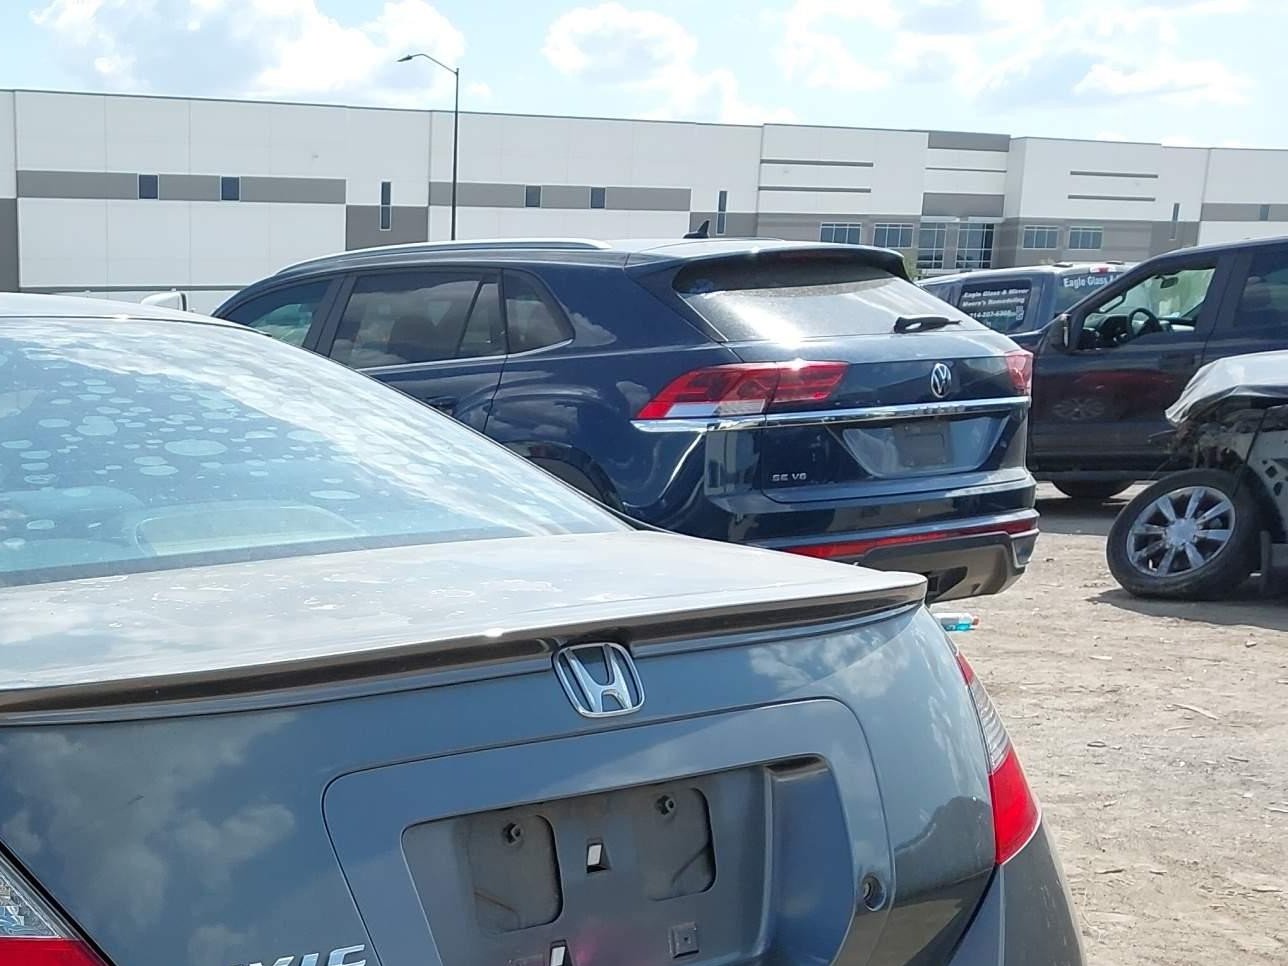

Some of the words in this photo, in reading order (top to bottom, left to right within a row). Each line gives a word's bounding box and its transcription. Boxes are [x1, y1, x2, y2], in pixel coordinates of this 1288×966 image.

[1063, 277, 1086, 289] Eagle
[772, 473, 789, 482] SE
[792, 472, 807, 481] V6
